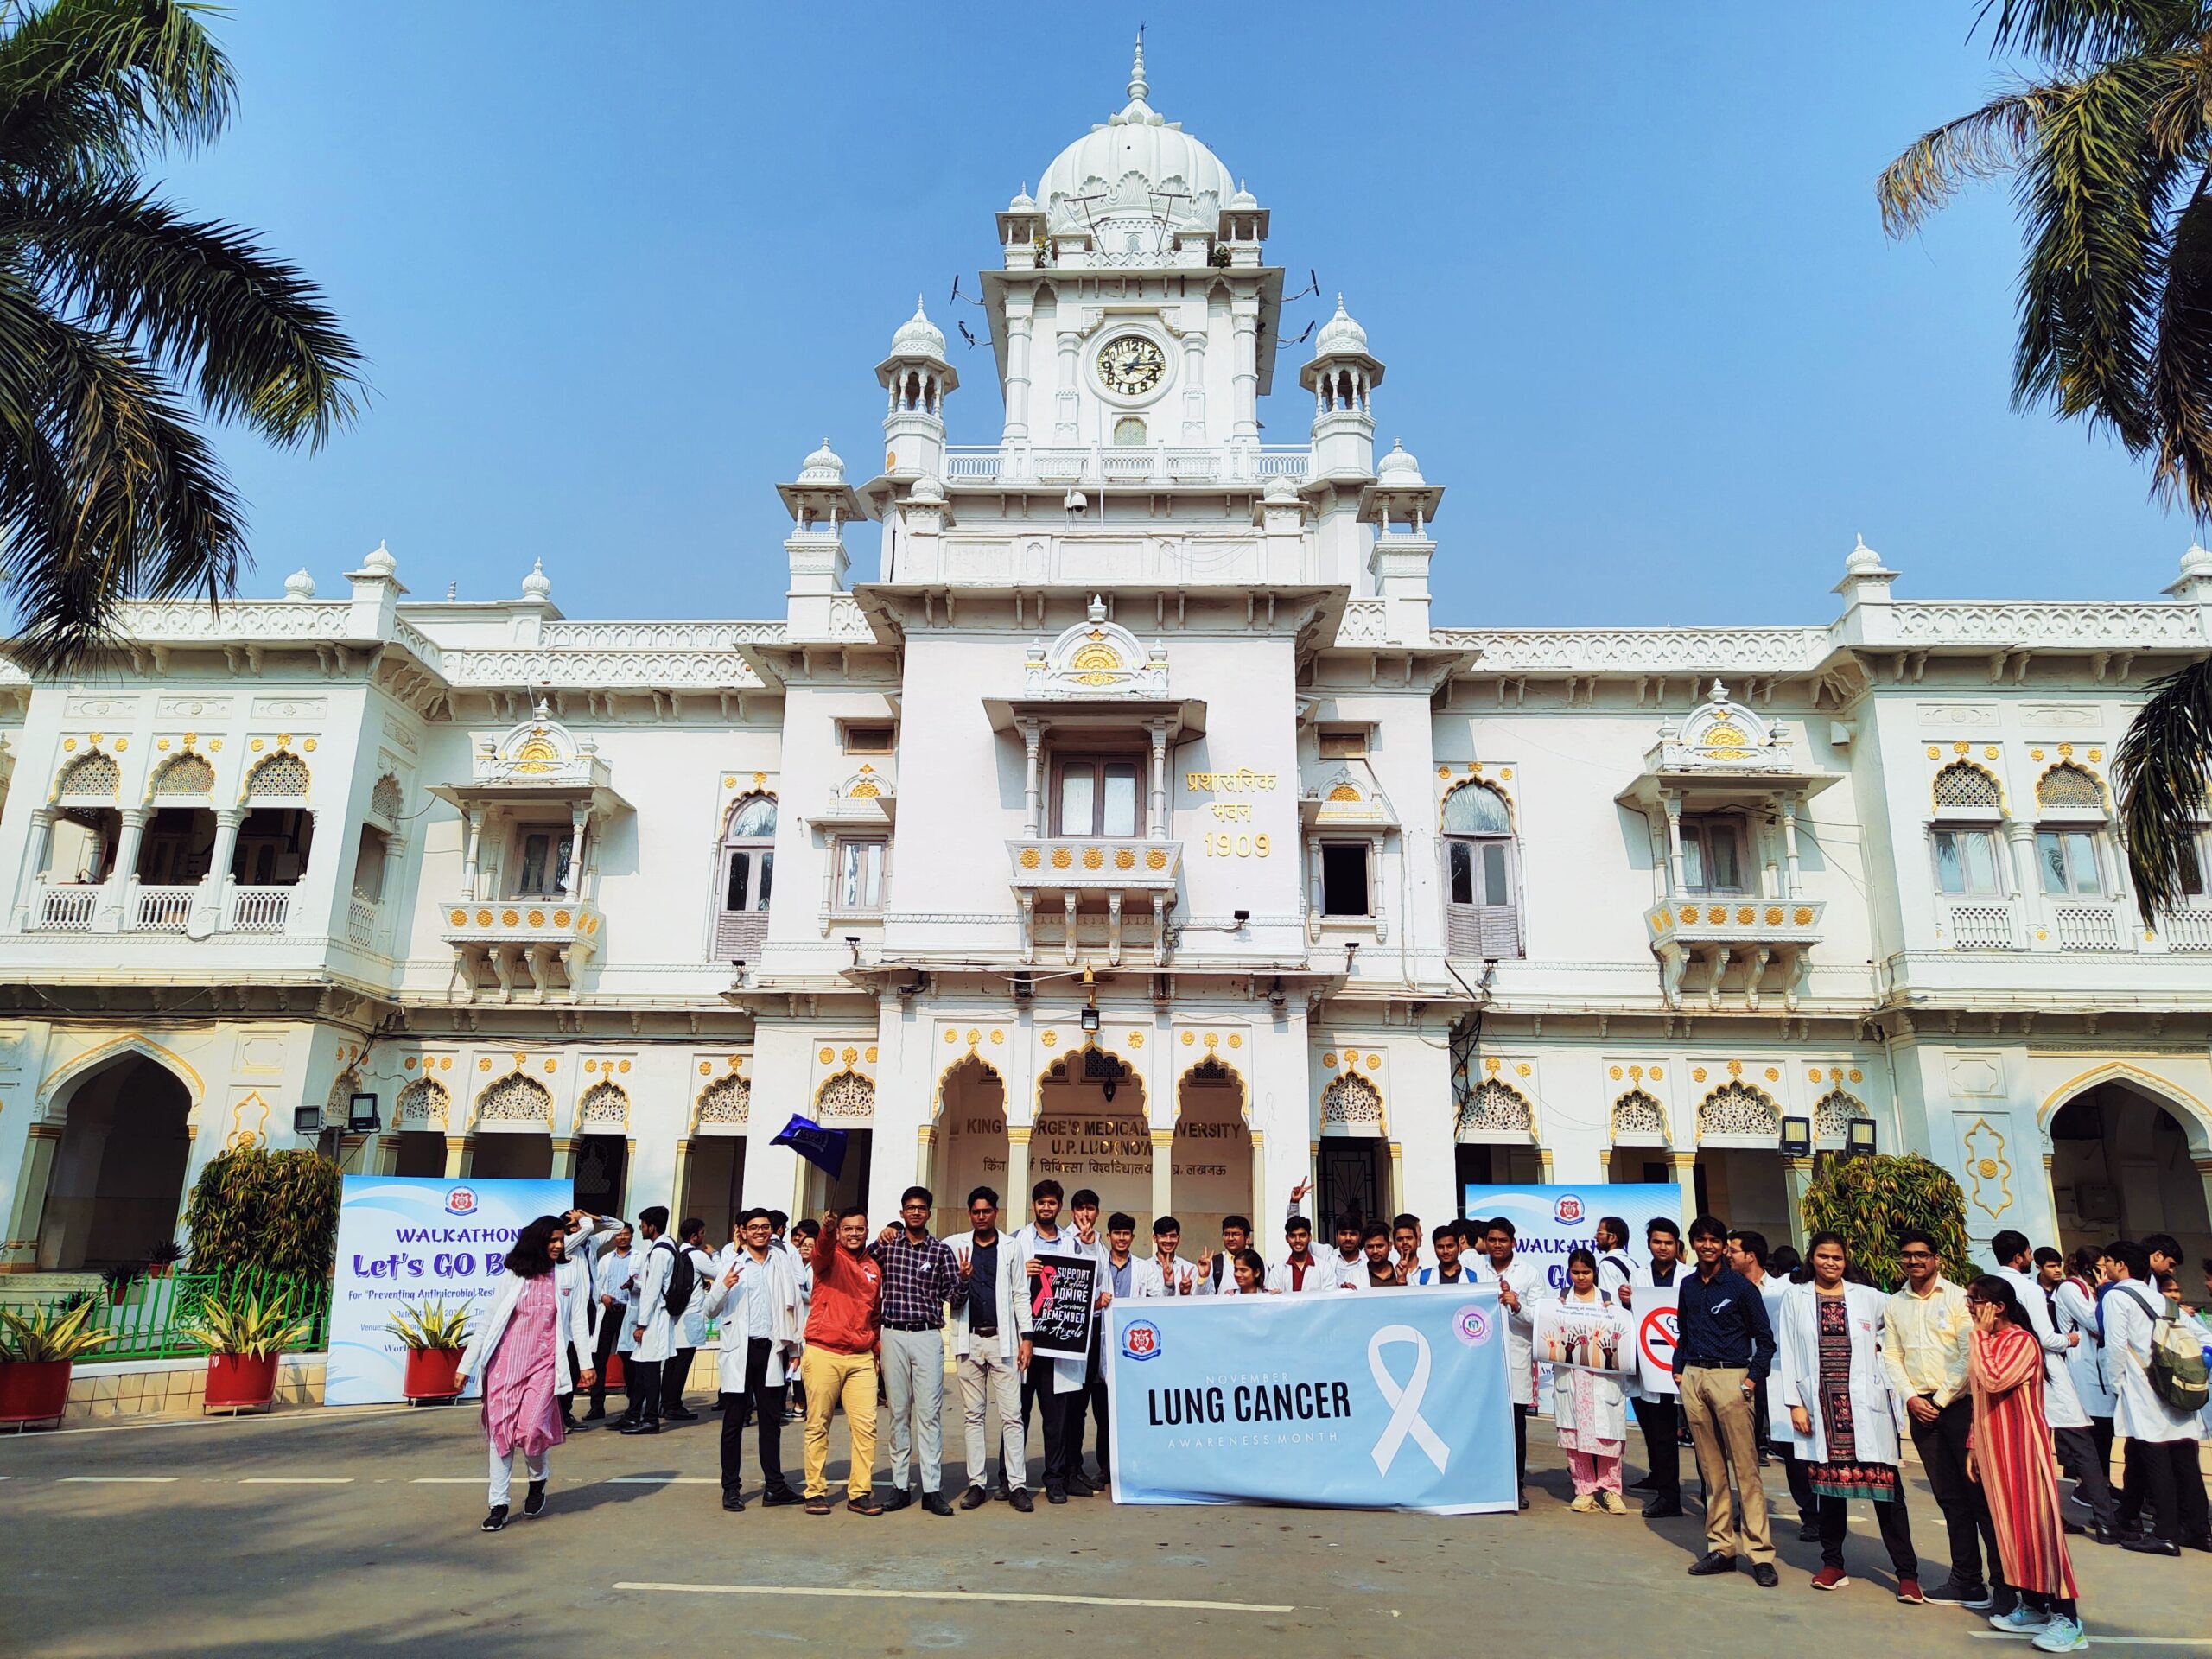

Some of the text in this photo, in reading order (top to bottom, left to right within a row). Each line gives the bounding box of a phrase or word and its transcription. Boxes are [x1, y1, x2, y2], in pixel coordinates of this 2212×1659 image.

[1114, 342, 1123, 356] 11
[1125, 340, 1139, 351] 12
[1105, 350, 1116, 363] 10
[1148, 350, 1156, 360] 2
[1102, 361, 1112, 373] 9
[1107, 372, 1115, 385] 8
[1146, 372, 1158, 383] 4
[1116, 381, 1122, 392] 7
[1128, 384, 1135, 394] 6
[1141, 381, 1147, 392] 5
[1186, 766, 1276, 792] प्रशासनिक
[1211, 804, 1251, 823] भवन
[1205, 832, 1270, 858] 1909
[967, 1119, 1241, 1139] KING RGE'S MEDICAL IVERSITY
[1052, 1140, 1153, 1156] U.P. LUCKNOW
[396, 1228, 523, 1243] WALKATHON
[353, 1253, 424, 1280] Let's
[433, 1252, 477, 1278] GO
[1049, 1274, 1061, 1287] The
[1057, 1267, 1090, 1281] SUPPORT
[1042, 1296, 1053, 1308] The
[1054, 1287, 1089, 1303] ADMIRE
[1042, 1308, 1085, 1324] REMEMBER
[1033, 1318, 1084, 1340] The Angels
[212, 1355, 219, 1368] 10
[1206, 1371, 1289, 1384] NOVEMBER
[1148, 1381, 1351, 1426] LUNG CANCER
[1167, 1432, 1338, 1449] AWARENESS MONTH
